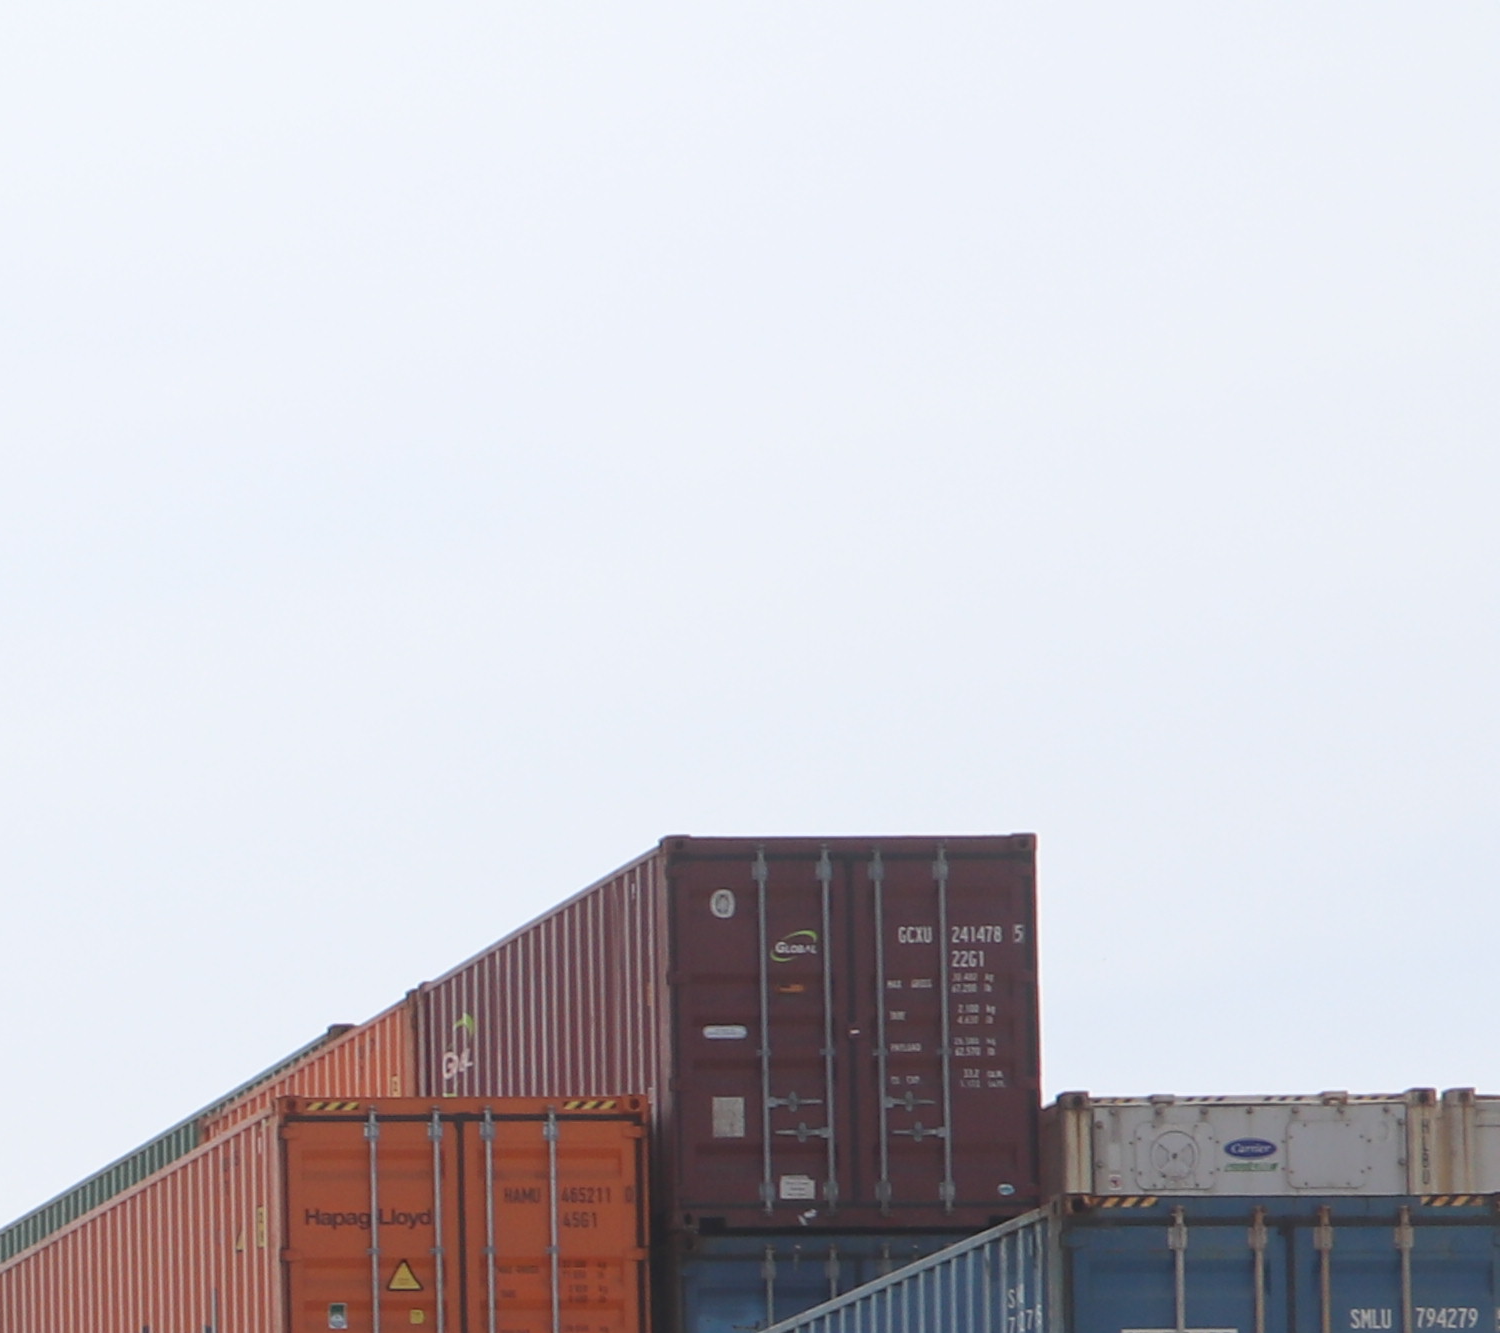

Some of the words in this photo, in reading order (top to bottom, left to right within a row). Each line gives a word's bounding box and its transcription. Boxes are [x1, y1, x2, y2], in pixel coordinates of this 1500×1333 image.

[898, 926, 933, 943] GCXU
[951, 925, 1003, 943] 241478
[1012, 924, 1024, 943] 5
[951, 950, 985, 967] 22G1
[1230, 1142, 1272, 1154] Carrier
[1350, 1308, 1392, 1329] SMLU
[1415, 1307, 1479, 1329] 794279
